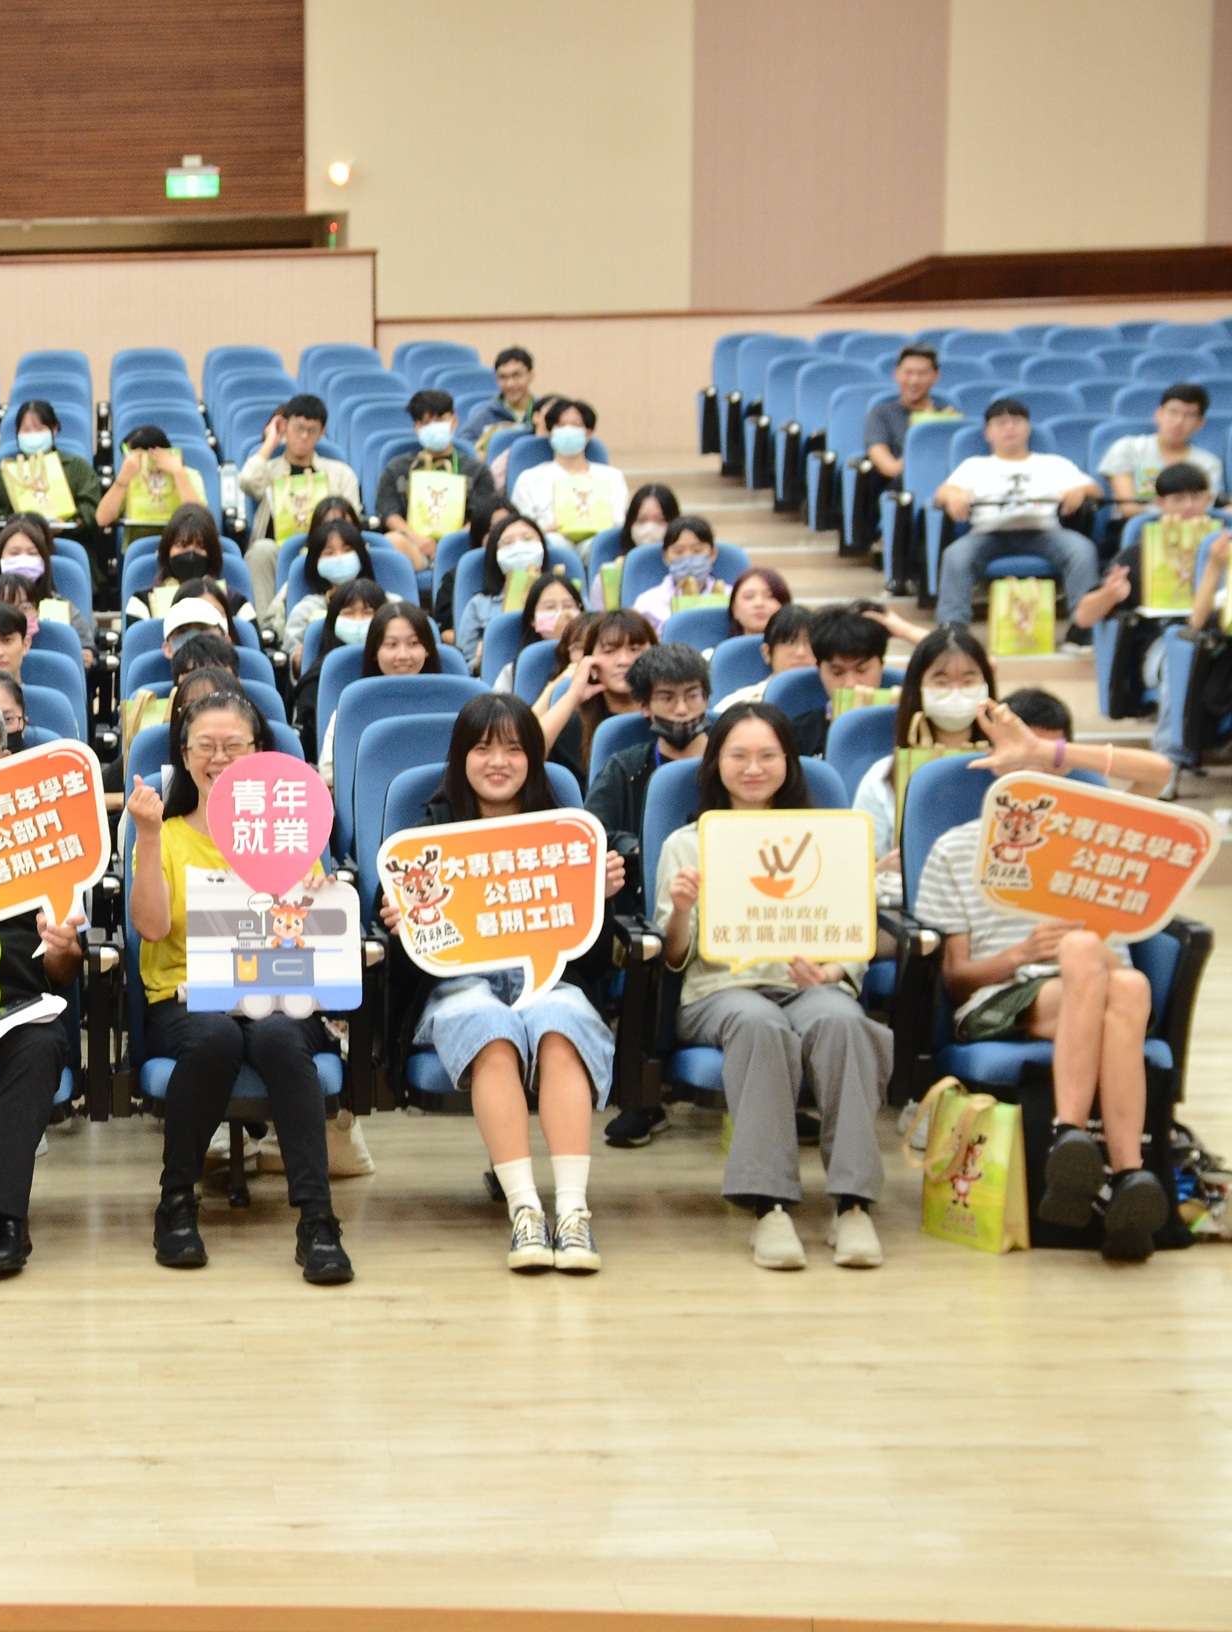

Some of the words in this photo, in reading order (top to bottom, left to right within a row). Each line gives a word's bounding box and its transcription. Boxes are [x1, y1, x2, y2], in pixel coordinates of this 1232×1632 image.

[231, 779, 307, 815] 青年
[231, 818, 309, 855] 就業
[1045, 811, 1197, 867] 大專青年學生
[442, 840, 591, 881] 大專青年學生
[1071, 847, 1150, 884] 公部門
[484, 874, 558, 906] 公部門
[1049, 870, 1151, 914] 暑期工讀
[476, 903, 576, 937] 暑期工讀
[746, 905, 829, 921] 桃園市政府
[712, 924, 864, 944] 就業職訓服務處
